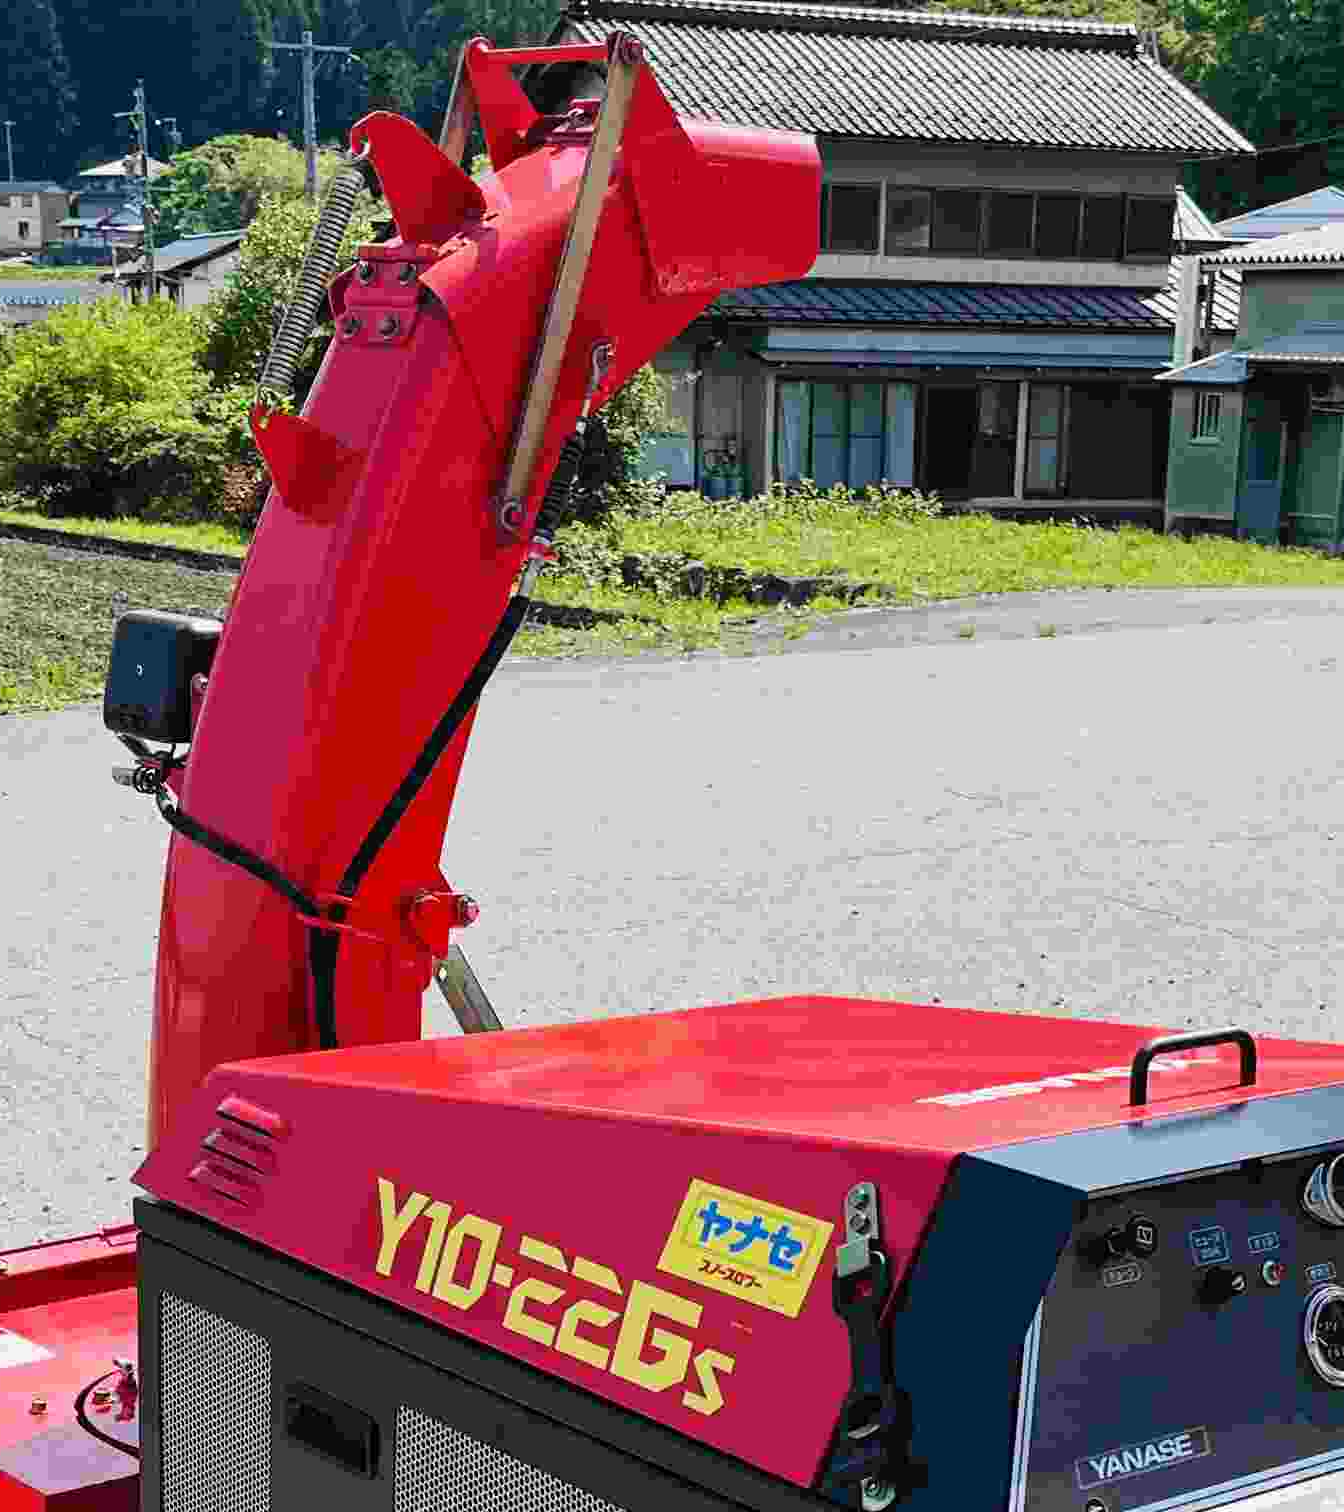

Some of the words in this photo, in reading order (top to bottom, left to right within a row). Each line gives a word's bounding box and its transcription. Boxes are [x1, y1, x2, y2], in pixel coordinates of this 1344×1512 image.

[698, 1199, 805, 1272] ヤナセ
[1088, 1434, 1193, 1479] YANASE
